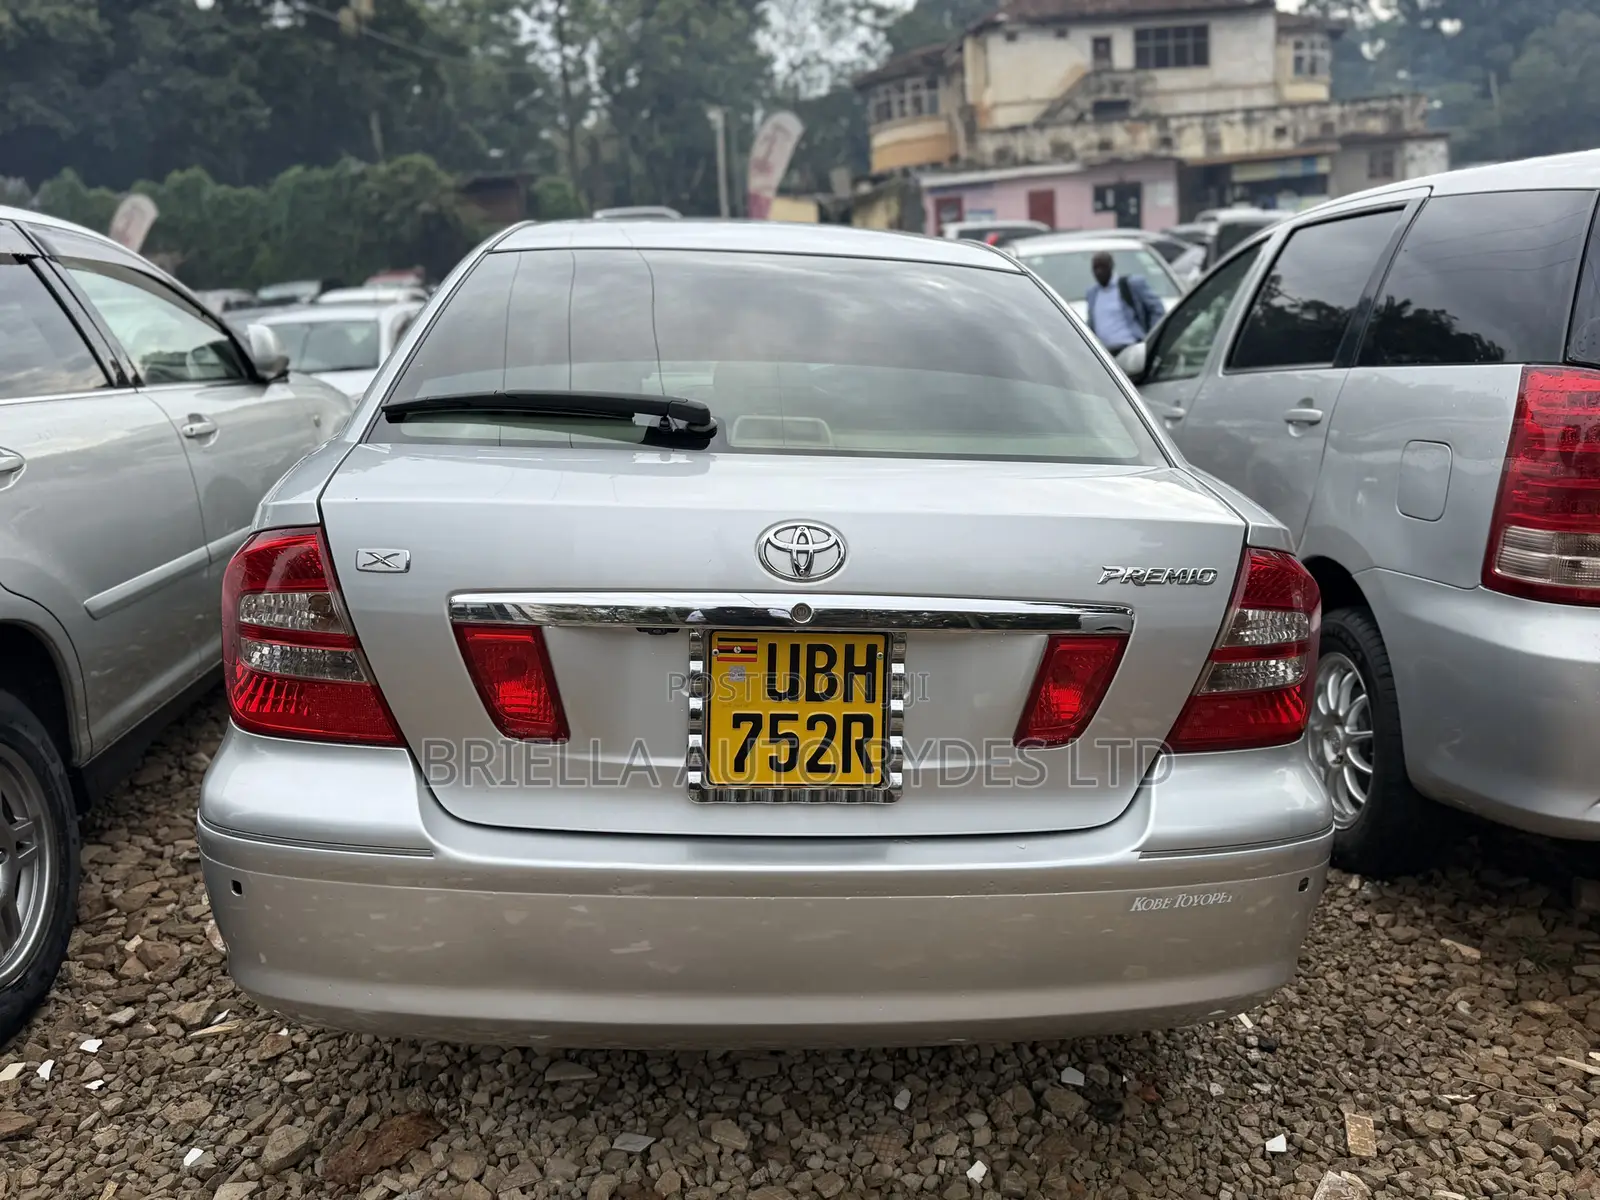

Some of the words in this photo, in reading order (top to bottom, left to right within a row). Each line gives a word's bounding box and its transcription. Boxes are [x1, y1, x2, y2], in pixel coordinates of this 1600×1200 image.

[1097, 565, 1218, 586] PREMIO
[767, 643, 878, 703] UBH
[732, 713, 875, 774] 752R
